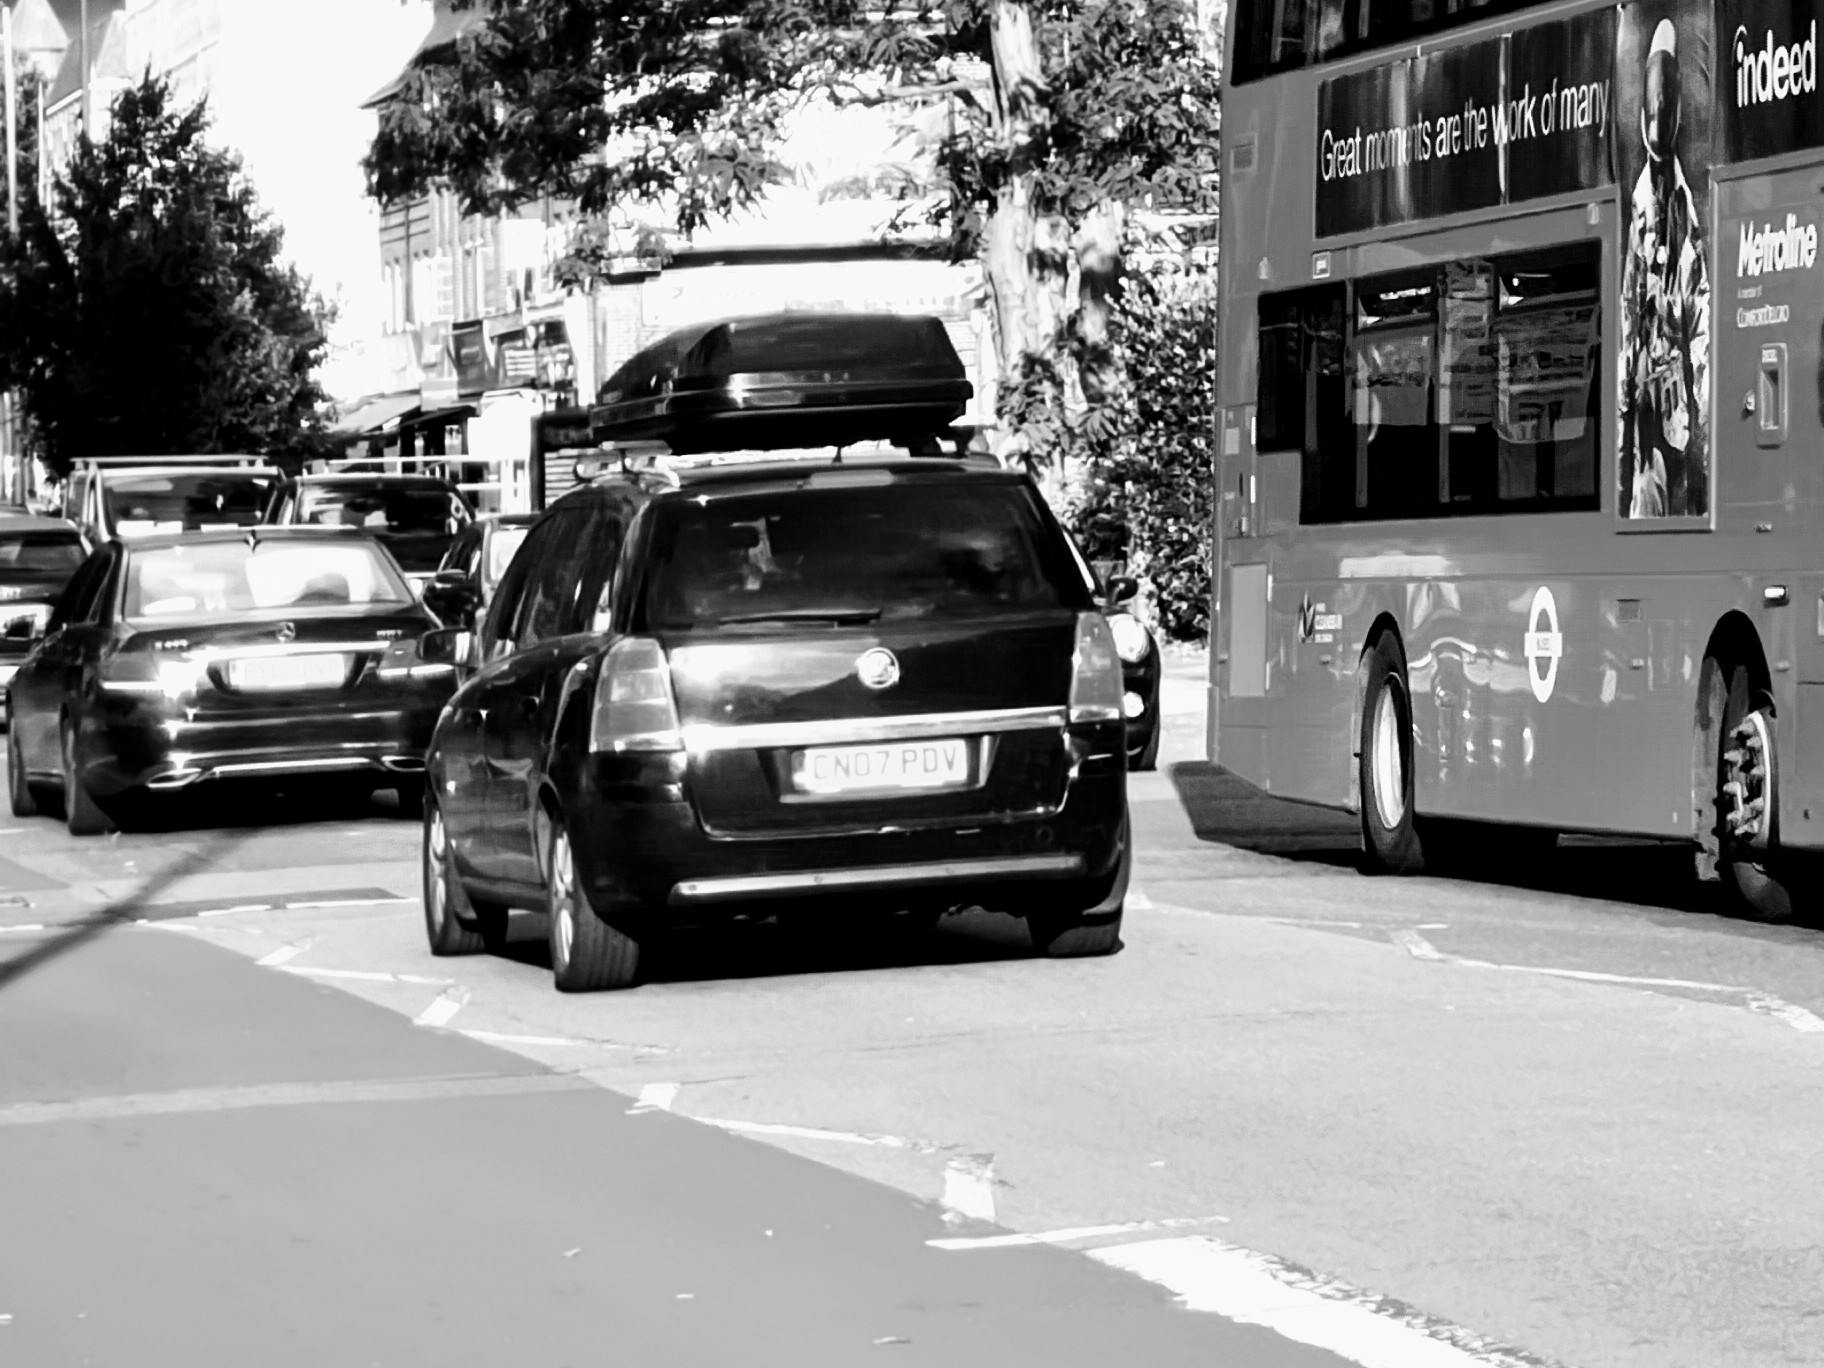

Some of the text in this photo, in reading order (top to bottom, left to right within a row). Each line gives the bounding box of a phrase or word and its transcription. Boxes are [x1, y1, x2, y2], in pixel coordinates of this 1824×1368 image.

[1732, 16, 1817, 109] indeed
[1320, 76, 1611, 182] Great moments are the work of many
[1736, 212, 1818, 277] Metroline
[901, 745, 957, 774] PDV
